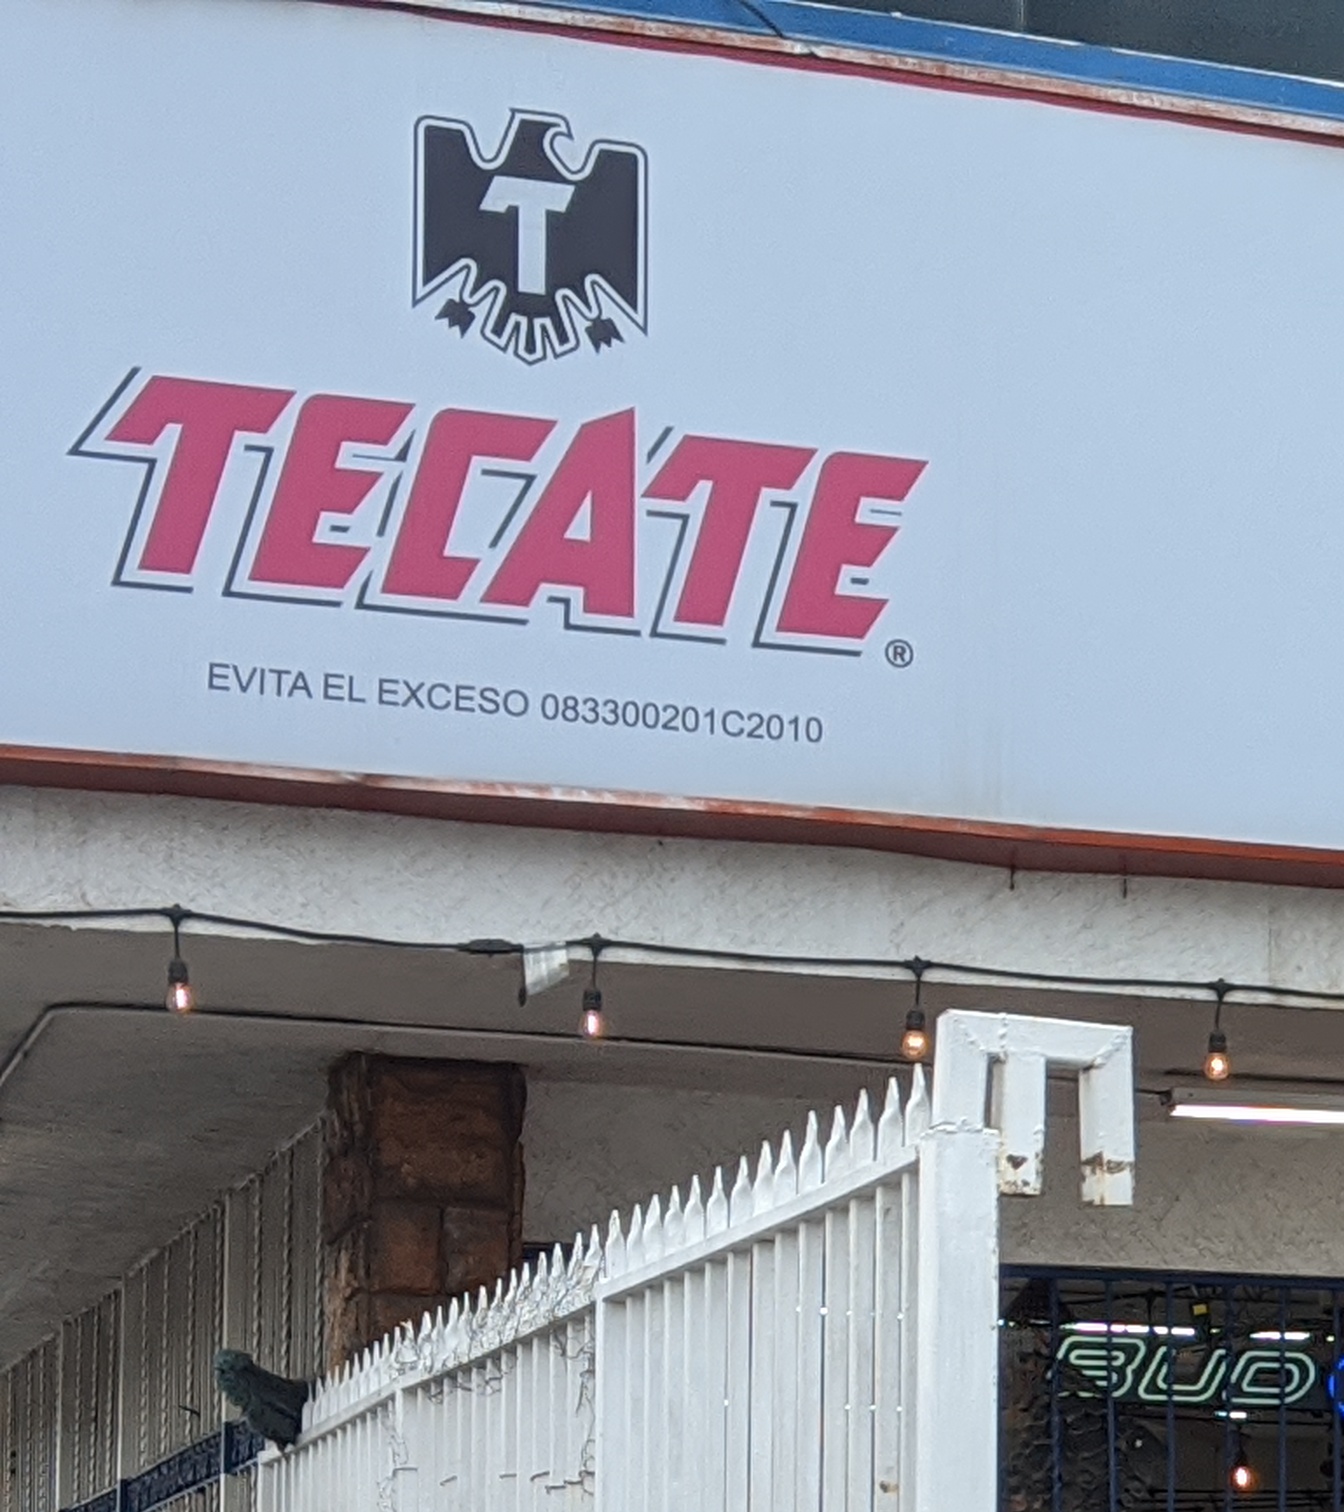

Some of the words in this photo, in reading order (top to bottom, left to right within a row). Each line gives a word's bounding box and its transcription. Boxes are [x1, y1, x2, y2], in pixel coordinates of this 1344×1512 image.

[69, 366, 930, 657] TECATE
[206, 661, 314, 700] EVITA
[322, 672, 367, 704] EL
[377, 677, 530, 718] EXCESO
[540, 692, 824, 744] 083300201C2010
[1053, 1333, 1317, 1406] BUD
